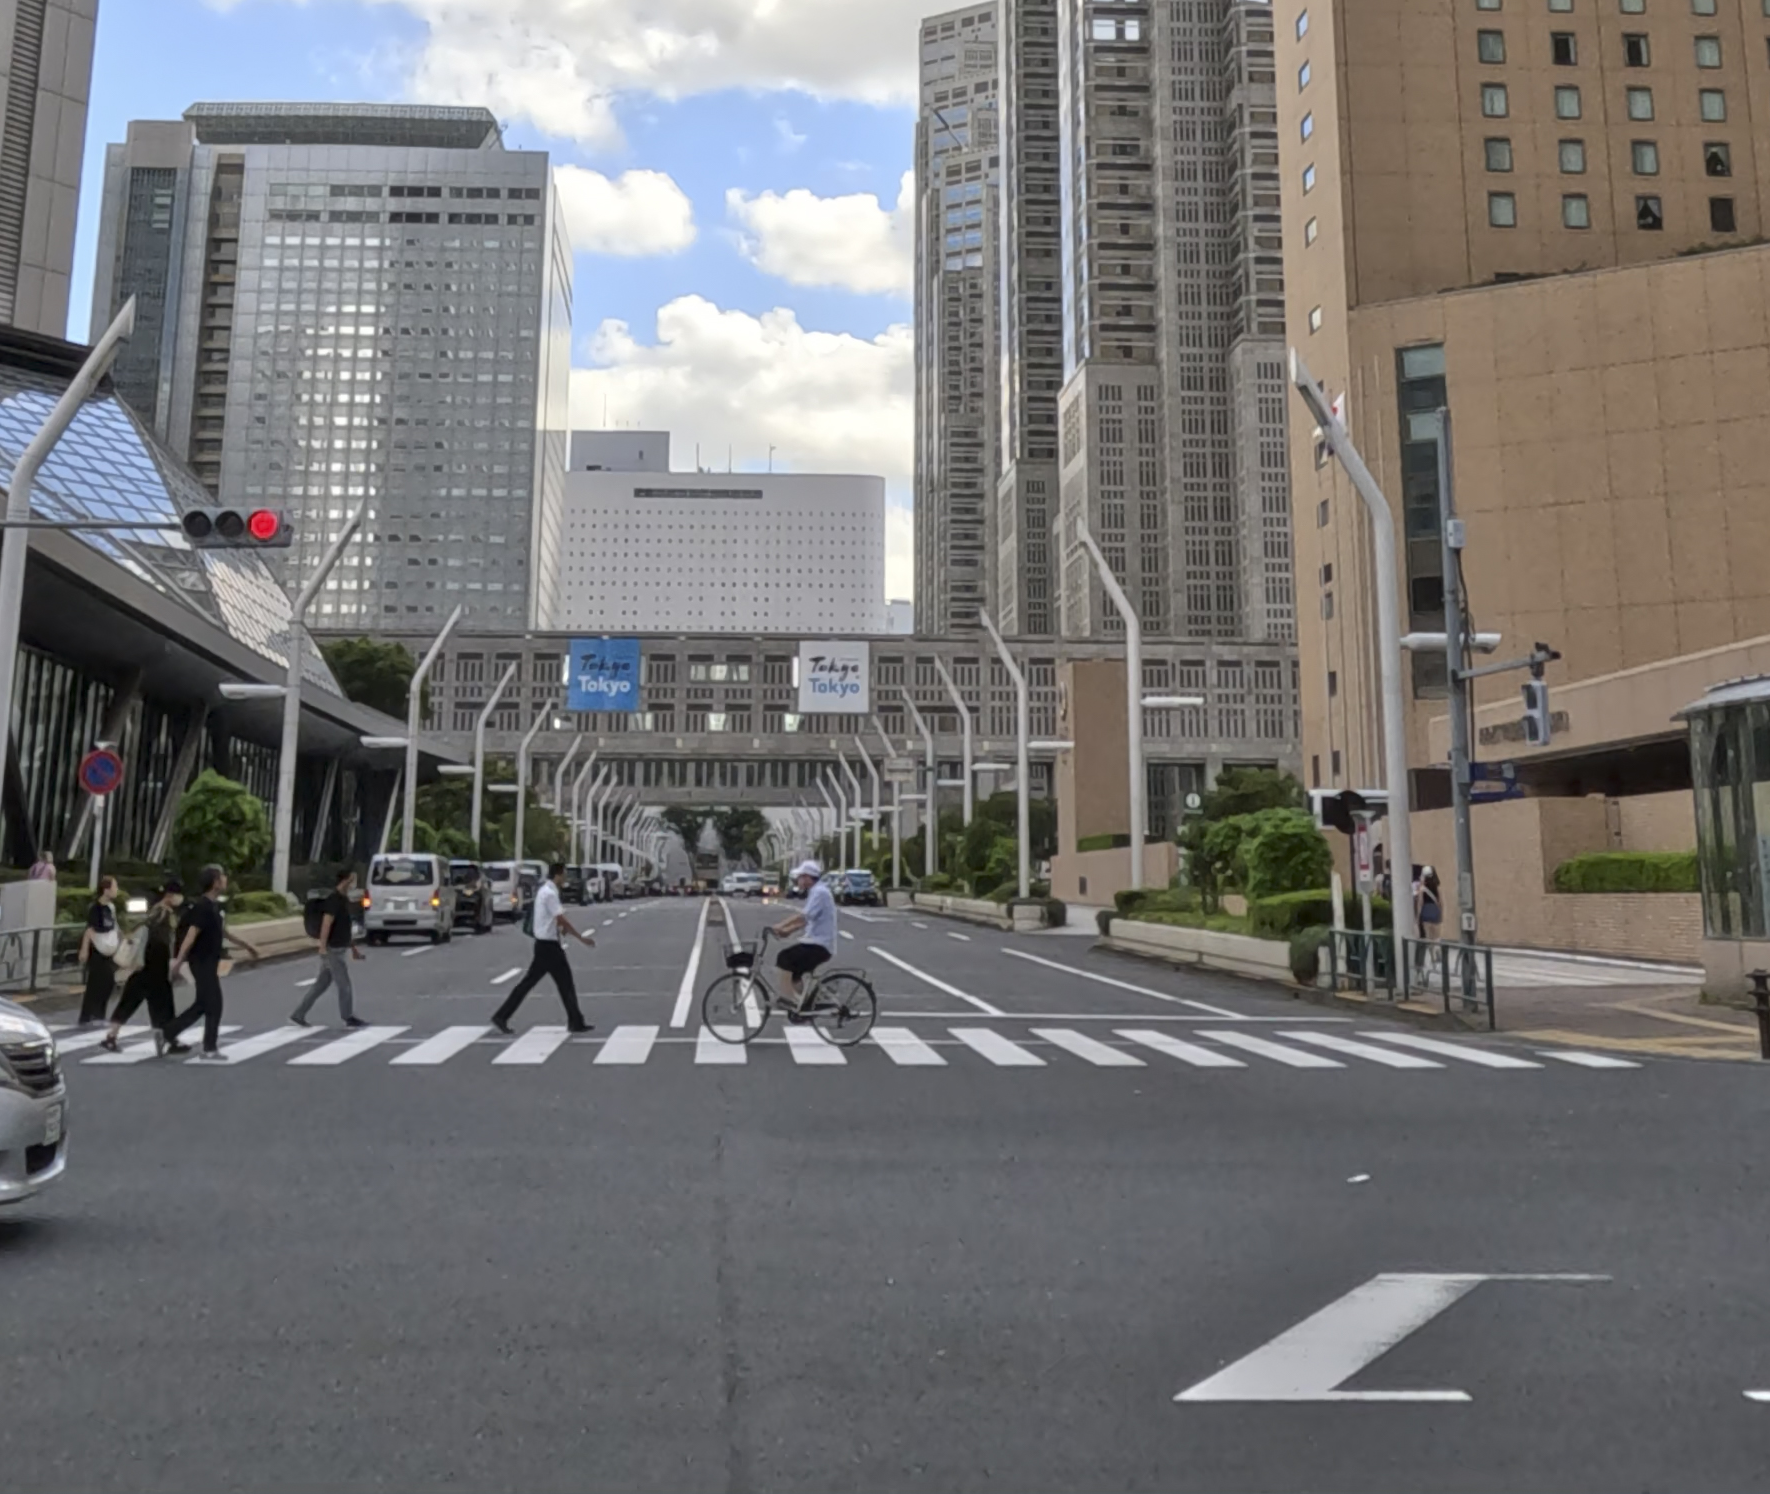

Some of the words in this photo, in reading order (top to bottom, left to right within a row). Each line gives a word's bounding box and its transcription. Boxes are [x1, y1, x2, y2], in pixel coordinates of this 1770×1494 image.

[580, 654, 631, 679] Tokyo
[809, 656, 859, 682] Tokyo
[577, 675, 631, 697] Tokyo
[808, 677, 860, 699] Tokyo
